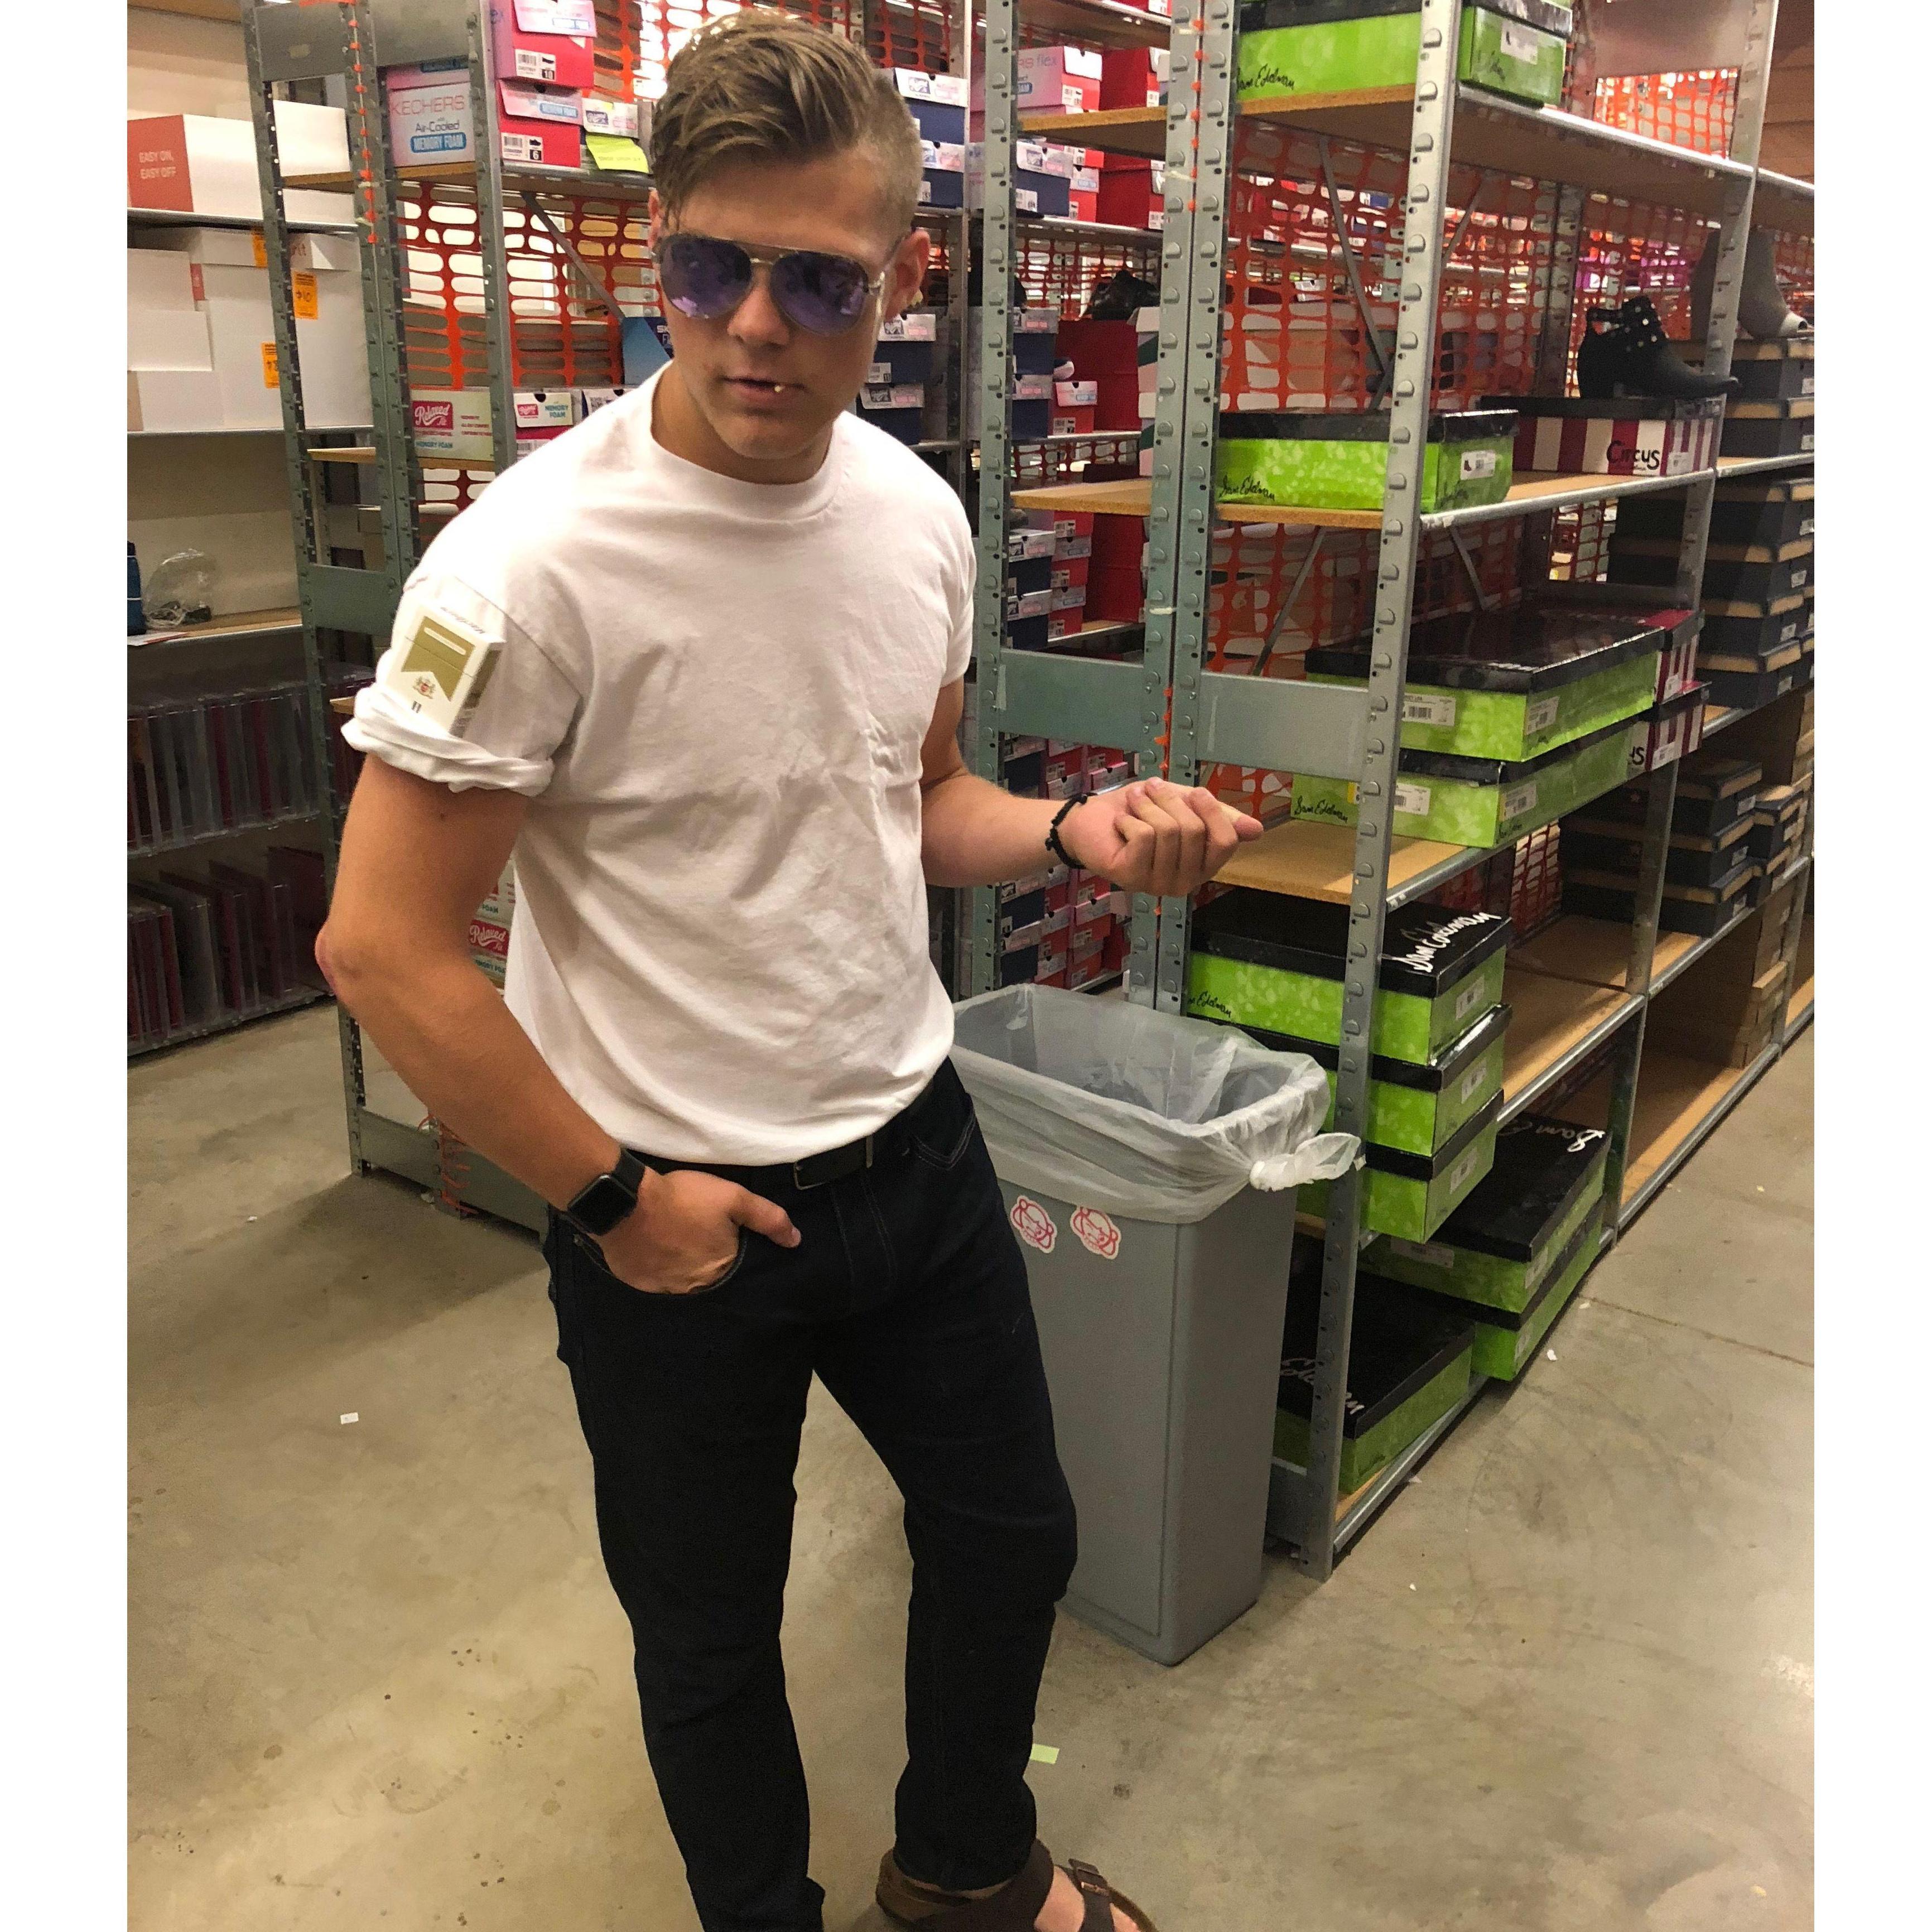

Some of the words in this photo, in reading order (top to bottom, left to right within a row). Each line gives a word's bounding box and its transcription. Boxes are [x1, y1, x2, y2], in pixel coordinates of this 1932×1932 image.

[1255, 62, 1295, 90] Edelman
[389, 95, 464, 115] KECHERS
[1607, 440, 1660, 470] Circus
[1240, 473, 1275, 501] Edelman
[1294, 794, 1313, 815] Sam
[1314, 799, 1348, 823] Edelman
[1399, 912, 1502, 948] Edelman
